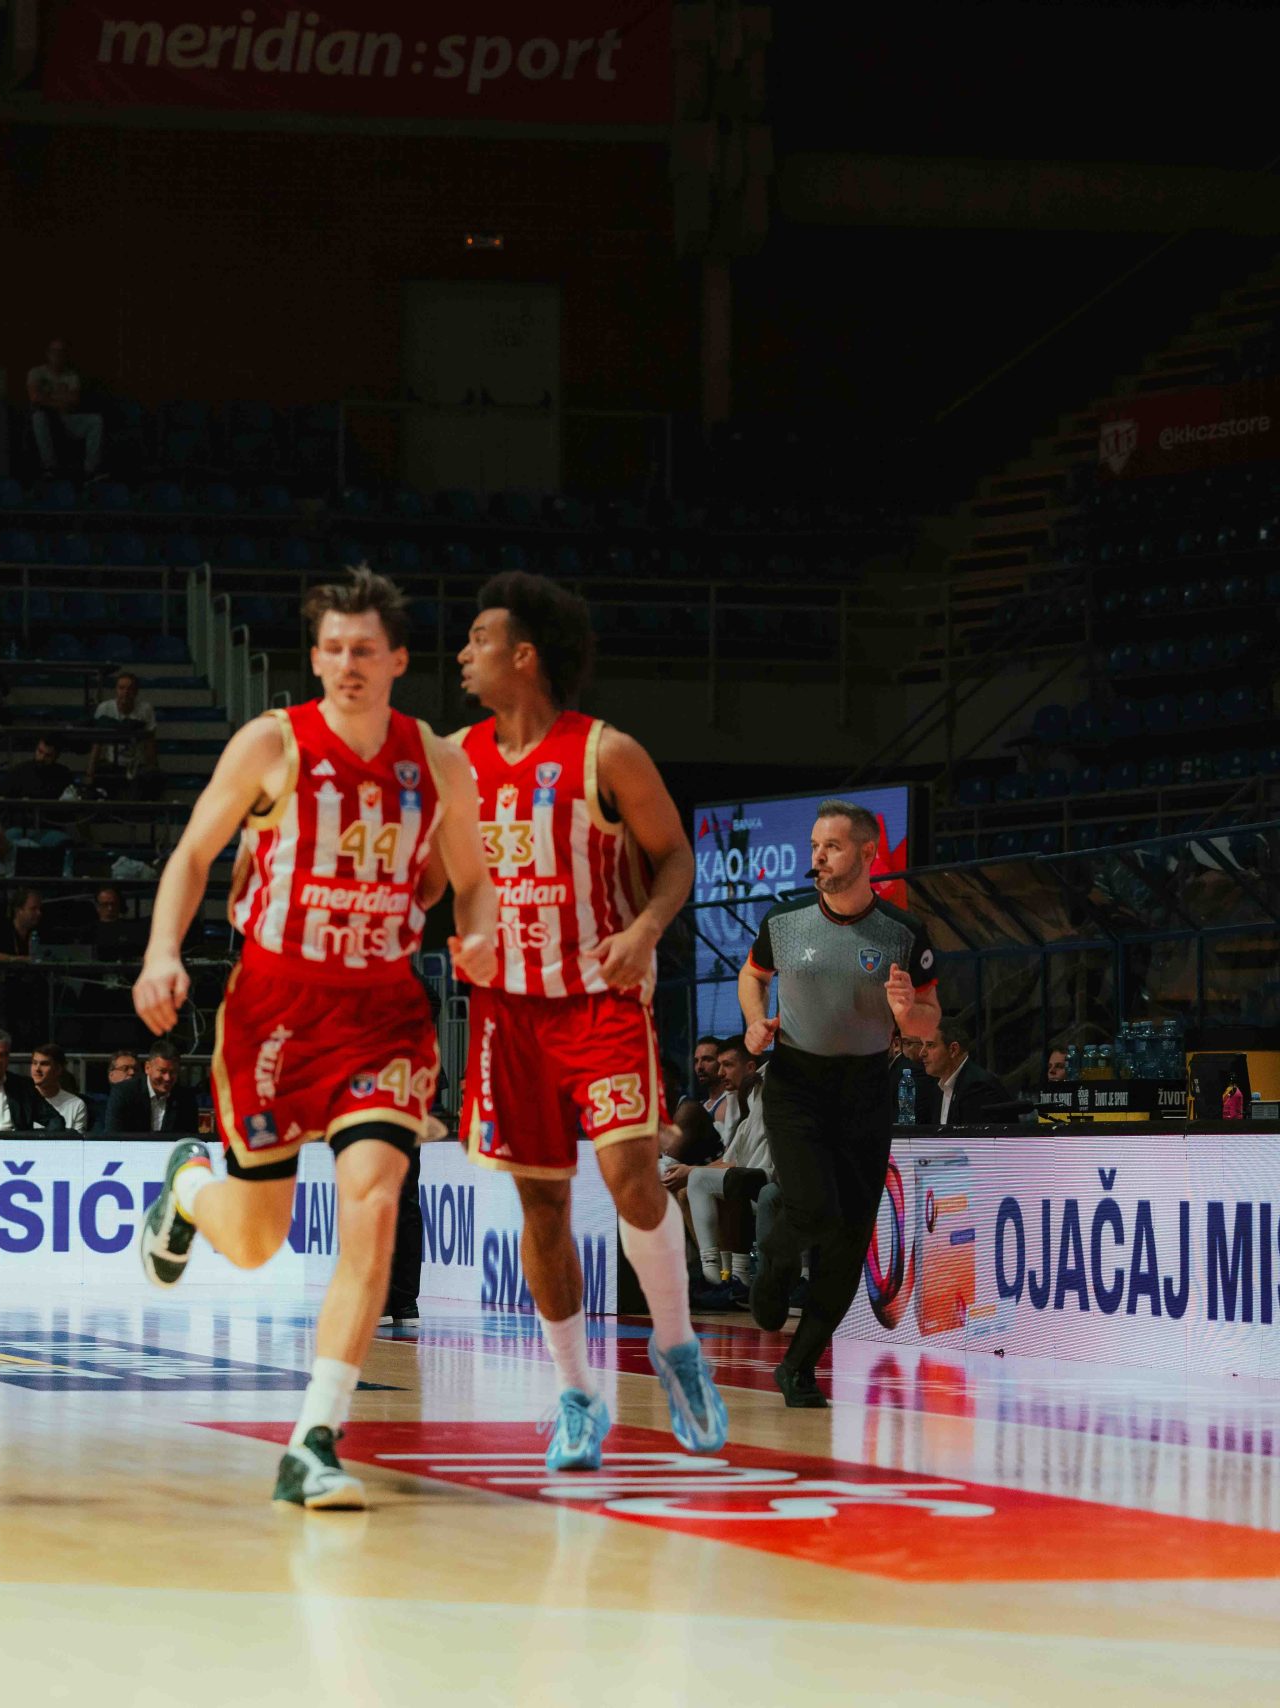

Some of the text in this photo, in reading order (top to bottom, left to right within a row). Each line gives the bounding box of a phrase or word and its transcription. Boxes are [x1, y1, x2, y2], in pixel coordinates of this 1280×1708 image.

[337, 819, 402, 873] 44
[480, 820, 535, 868] 33
[696, 843, 797, 884] KAO KOD
[495, 878, 567, 905] ridian
[316, 921, 389, 958] mts
[588, 1073, 646, 1127] 33
[1158, 1088, 1186, 1105] ŽIVOT
[995, 1167, 1280, 1325] OJAČAJ MI
